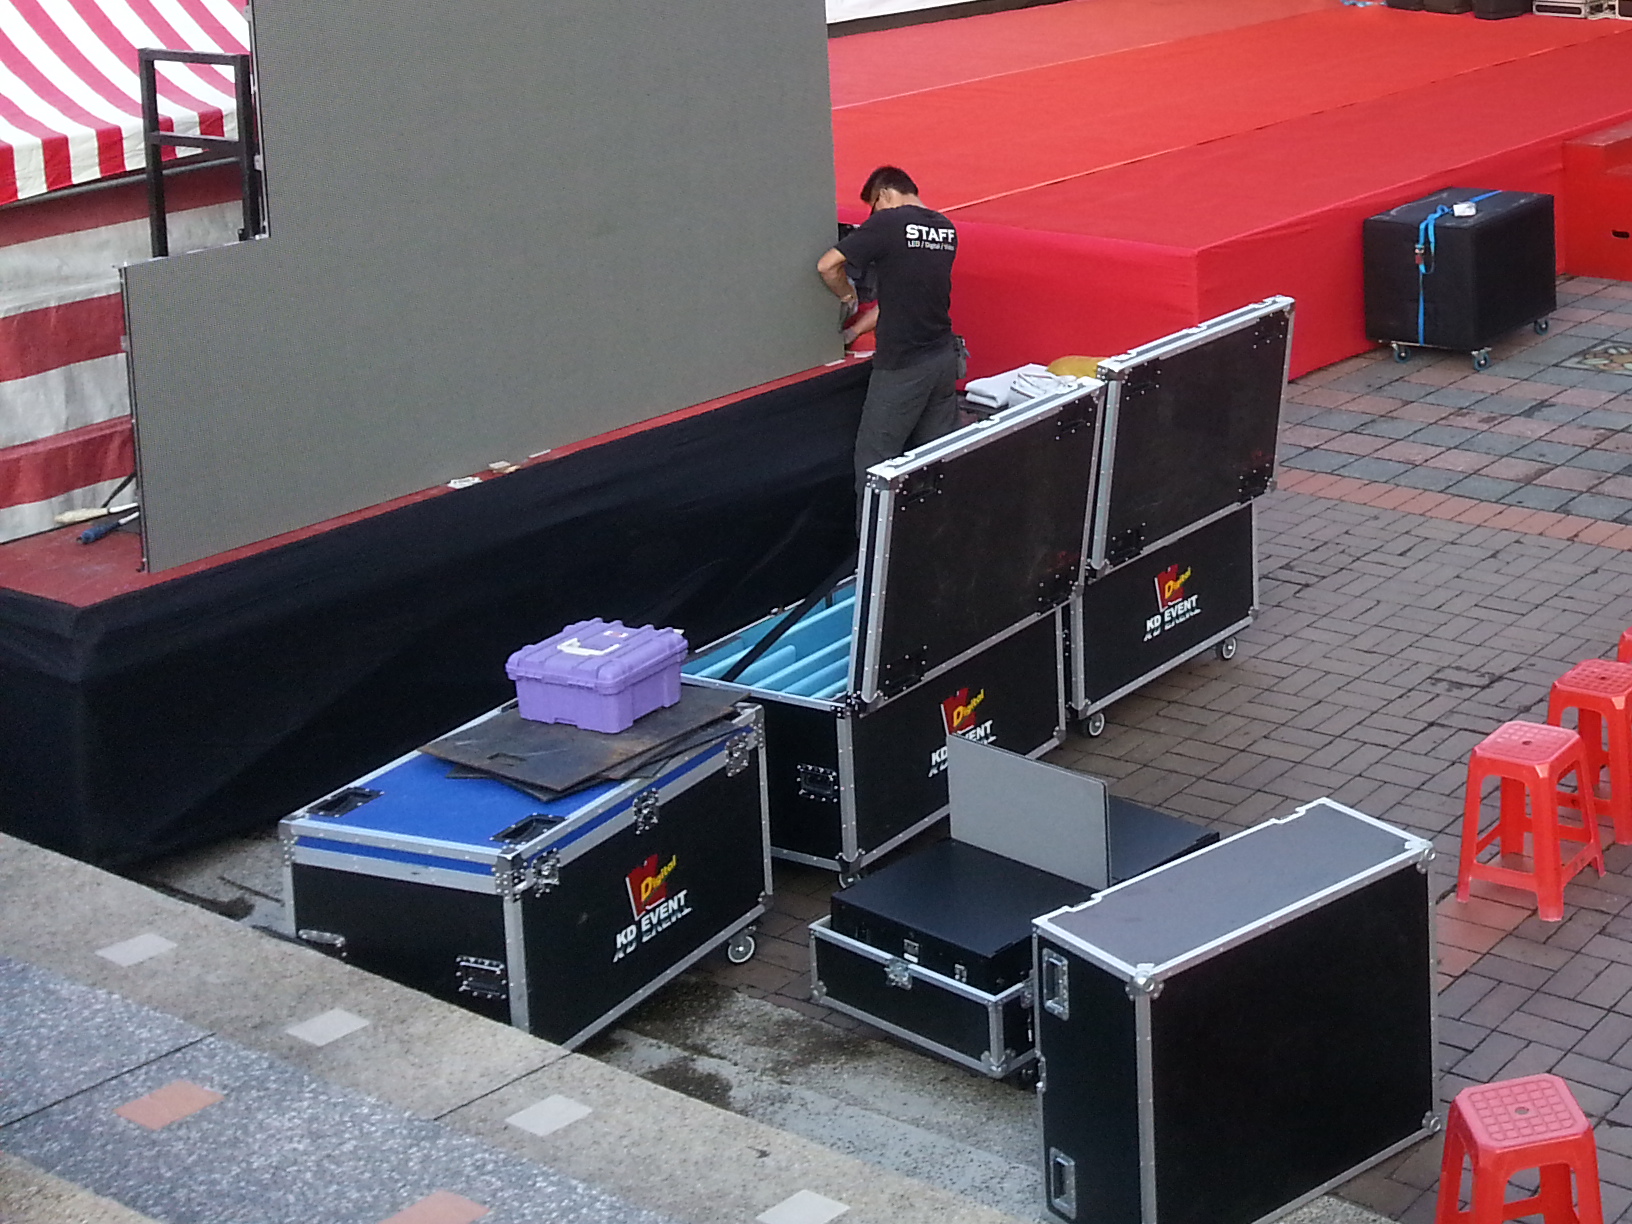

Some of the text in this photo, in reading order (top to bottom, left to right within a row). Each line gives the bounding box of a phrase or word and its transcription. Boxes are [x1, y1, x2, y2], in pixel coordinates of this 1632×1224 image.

[906, 224, 955, 243] STAFF
[1146, 594, 1199, 632] KD EVENT
[616, 888, 688, 950] KD EVENT
